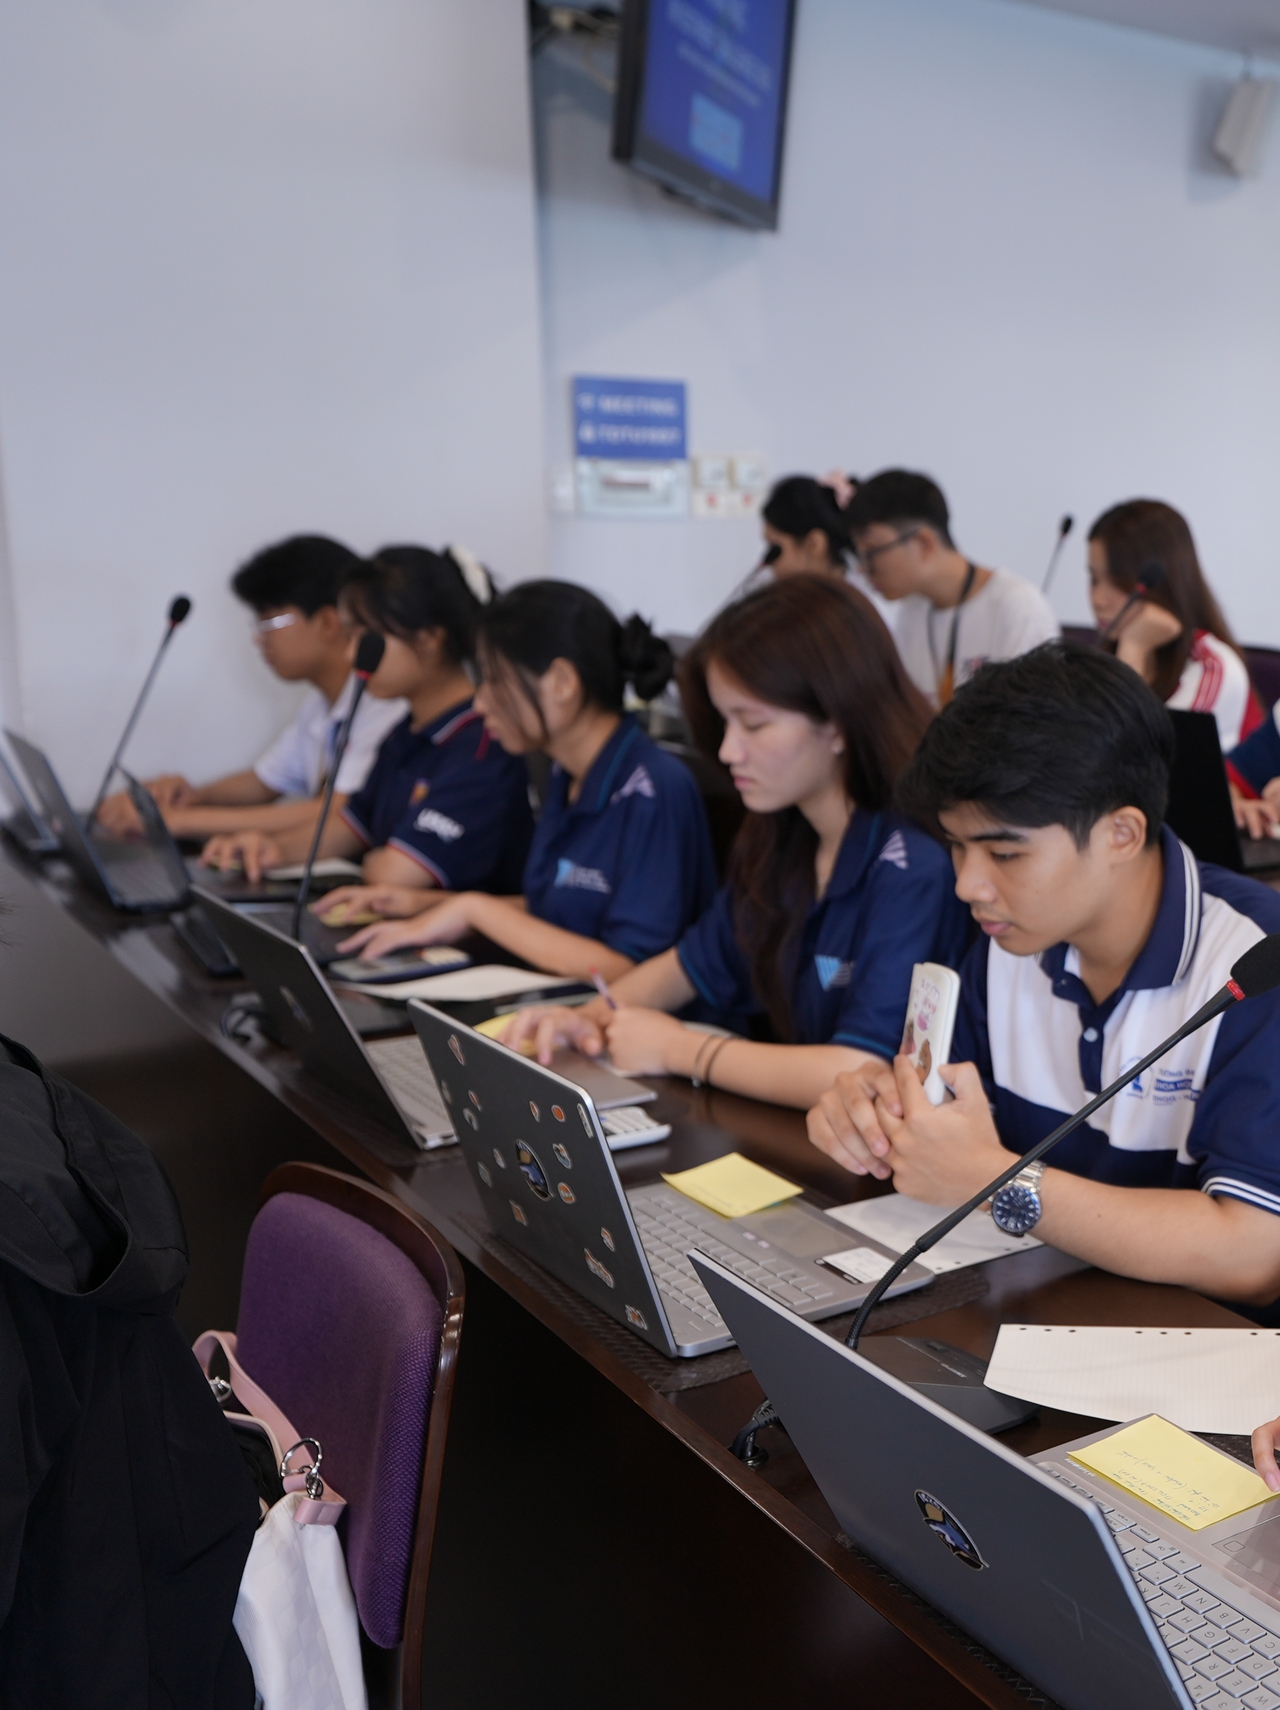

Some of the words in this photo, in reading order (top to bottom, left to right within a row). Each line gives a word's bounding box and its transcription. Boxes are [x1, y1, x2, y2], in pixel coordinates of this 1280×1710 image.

[1180, 1615, 1193, 1624] H
[1204, 1631, 1216, 1639] G
[1264, 1641, 1276, 1649] C
[1208, 1663, 1219, 1671] R
[1252, 1662, 1264, 1670] D
[1232, 1679, 1243, 1687] E
